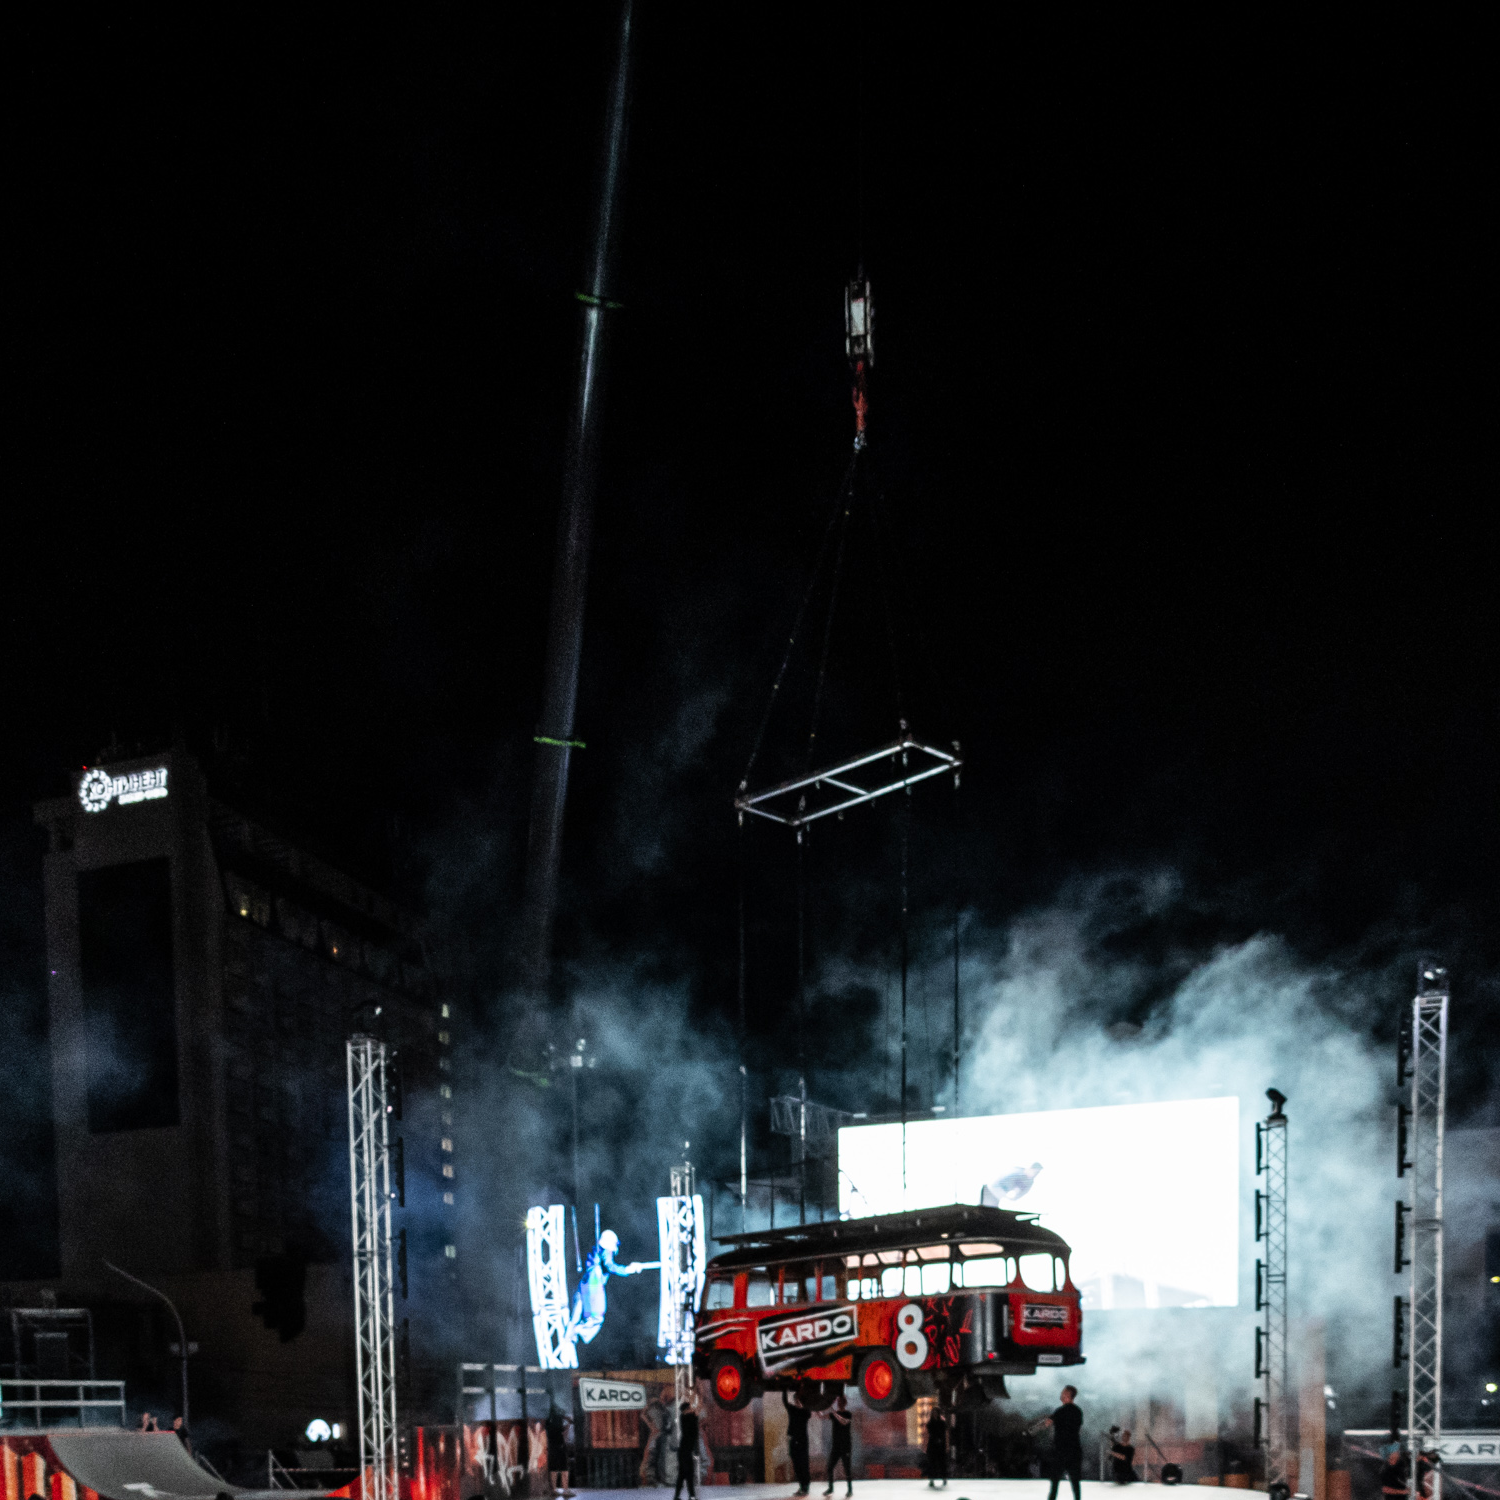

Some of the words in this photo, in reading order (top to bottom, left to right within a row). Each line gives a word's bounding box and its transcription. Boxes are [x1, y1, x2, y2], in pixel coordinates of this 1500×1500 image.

[1023, 1308, 1068, 1320] KARDO
[760, 1314, 851, 1350] KARDO
[896, 1303, 928, 1369] 8
[585, 1387, 643, 1402] KARDO
